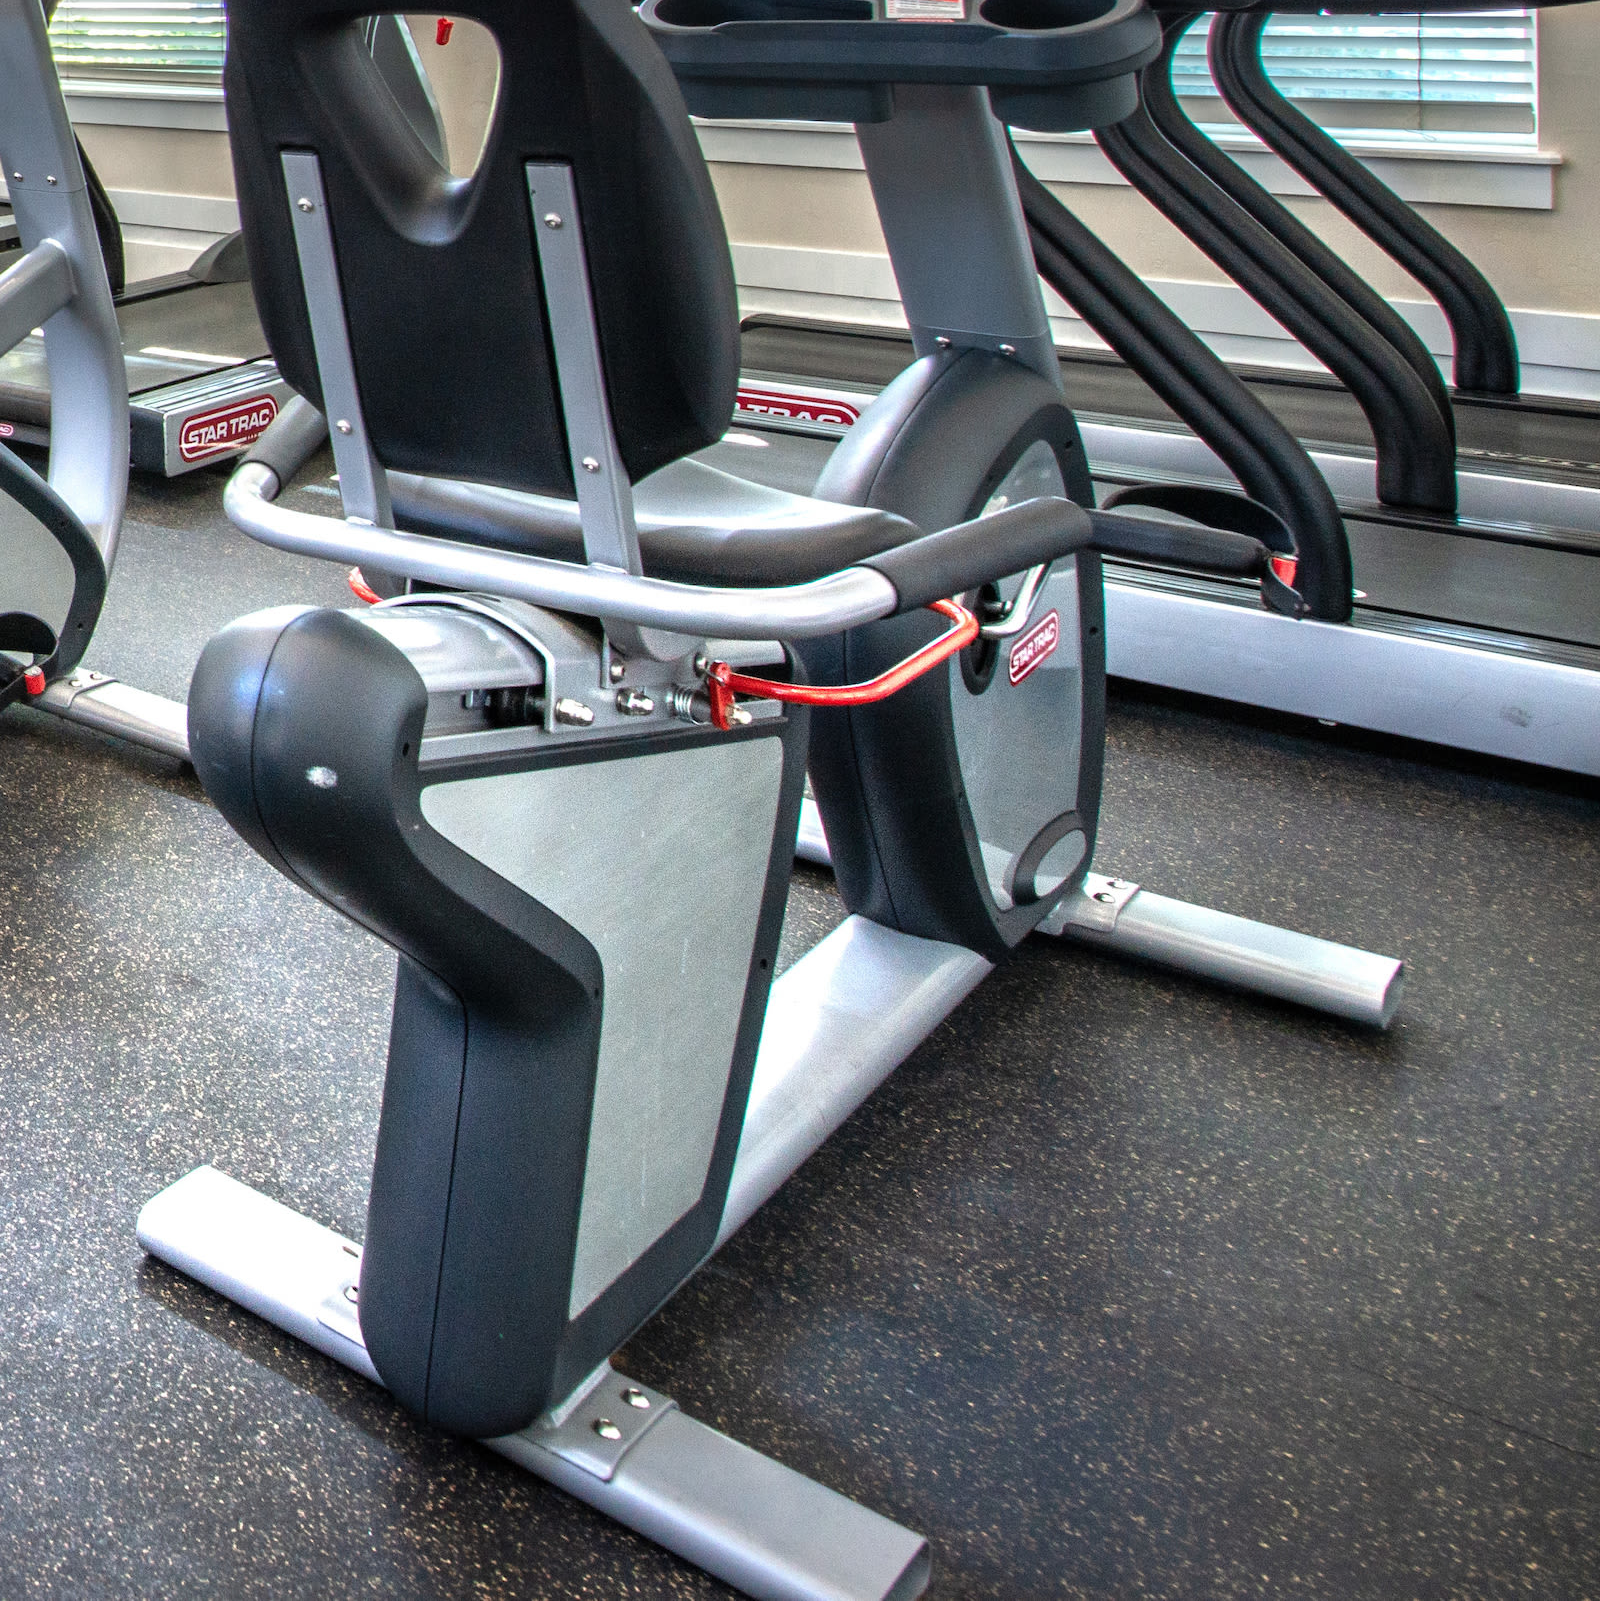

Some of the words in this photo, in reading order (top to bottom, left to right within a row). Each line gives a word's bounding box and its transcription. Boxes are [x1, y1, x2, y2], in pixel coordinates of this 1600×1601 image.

[186, 421, 228, 447] STAR
[229, 408, 270, 435] TRAC
[1012, 641, 1034, 669] STAR
[1033, 622, 1055, 652] TRAC
